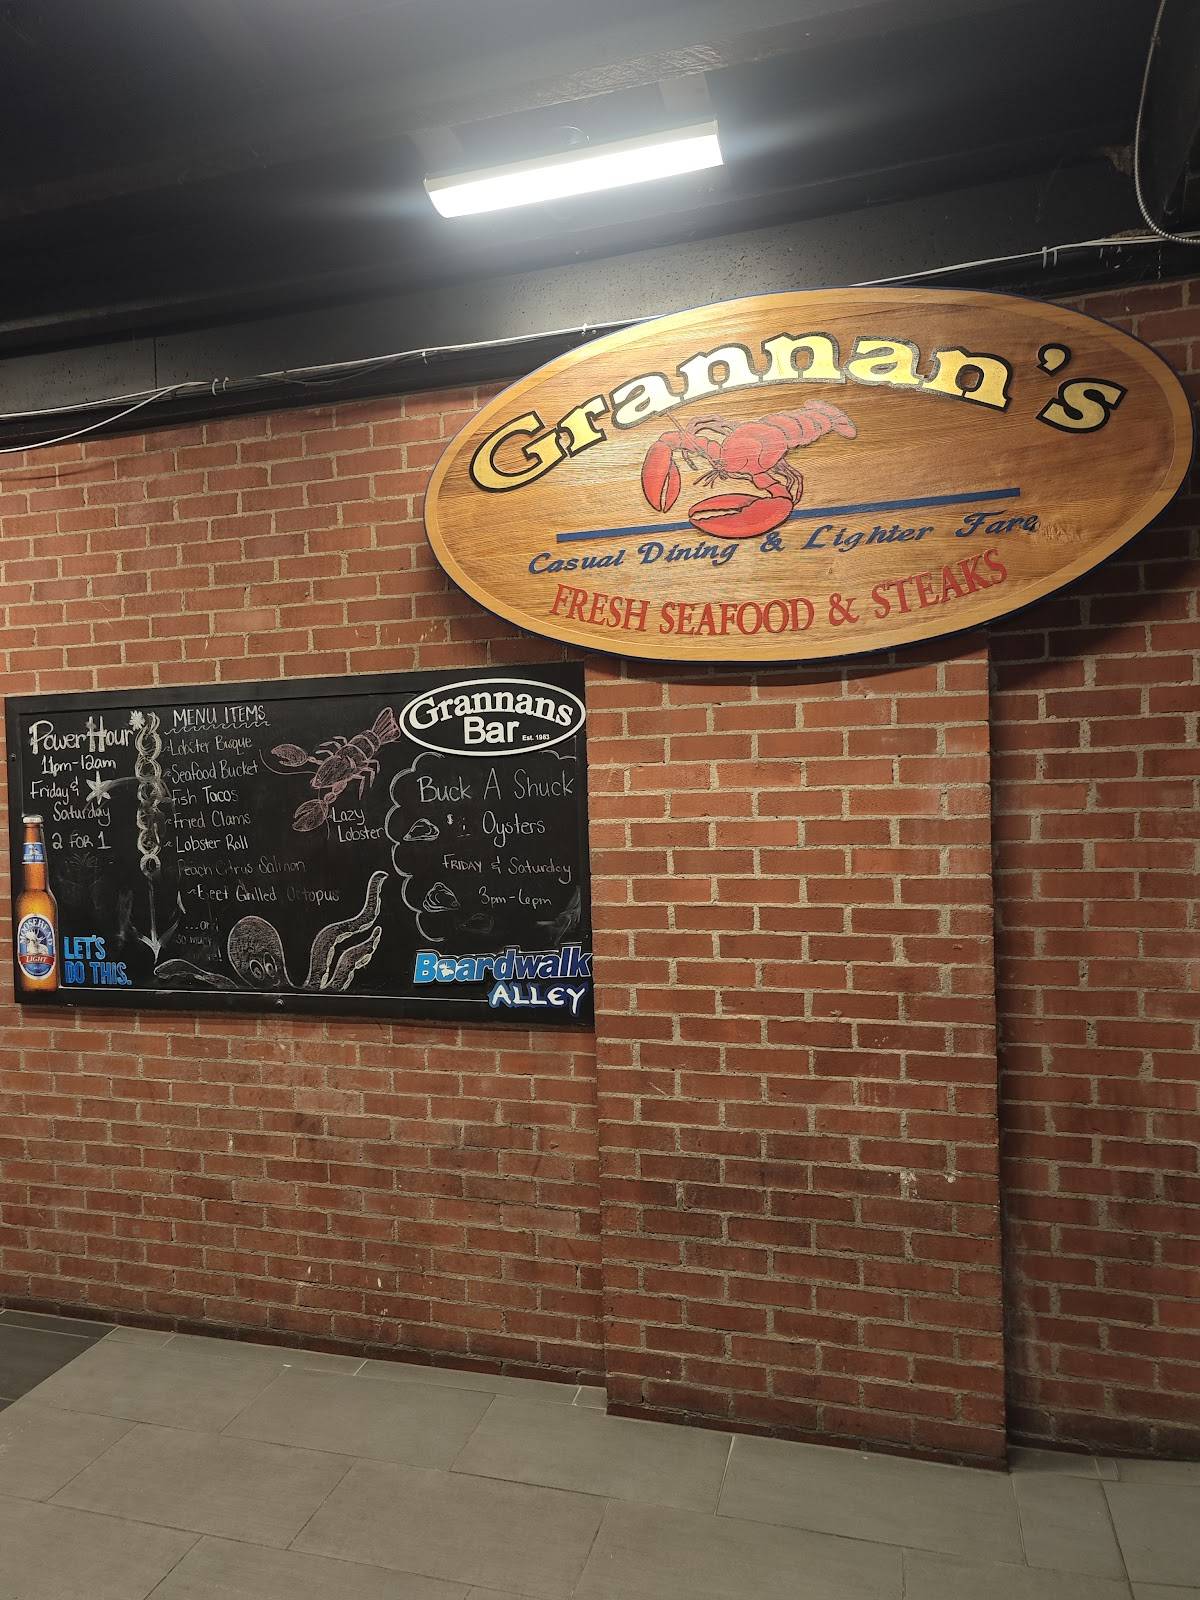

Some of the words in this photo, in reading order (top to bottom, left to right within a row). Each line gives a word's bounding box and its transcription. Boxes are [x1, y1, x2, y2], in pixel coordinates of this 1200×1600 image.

[469, 331, 1128, 493] Grannan's
[528, 549, 626, 574] Casual
[638, 540, 739, 566] Dining
[760, 532, 785, 551] &
[804, 524, 934, 552] Lighter
[954, 509, 1039, 538] Fare
[549, 583, 651, 632] FRESH
[659, 597, 814, 636] SEAFOOD
[828, 592, 860, 626] &
[871, 546, 1008, 620] STEAKS
[173, 708, 217, 727] MENU
[225, 705, 266, 724] ITEMS
[409, 690, 574, 730] Grannans
[463, 716, 520, 744] Bar
[215, 735, 253, 756] Bisque
[171, 762, 217, 784] Seafood
[221, 759, 258, 778] Bucket
[30, 781, 70, 807] Friday
[171, 788, 197, 806] Fish
[202, 785, 239, 804] Tacos
[417, 775, 473, 803] Buck
[483, 768, 501, 800] A
[513, 768, 574, 800] Shuck
[53, 803, 111, 827] Saturday
[173, 812, 206, 829] Fried
[211, 809, 251, 827] Clams
[331, 807, 366, 825] Lazy
[52, 832, 63, 849] 2
[97, 831, 112, 850] 1
[337, 825, 384, 843] Lobster
[482, 810, 545, 847] Oysters
[176, 835, 220, 853] Lobster
[226, 833, 249, 850] Roll
[177, 858, 212, 876] Peach
[258, 855, 305, 874] Salmon
[508, 856, 571, 884] Saturday
[236, 883, 277, 902] Grilled
[26, 955, 48, 963] LIGHT
[64, 935, 107, 960] LET'S
[64, 961, 86, 984] DO
[90, 961, 132, 985] THIS.
[413, 946, 593, 983] Boardwalk
[490, 983, 587, 1015] ALLEY
